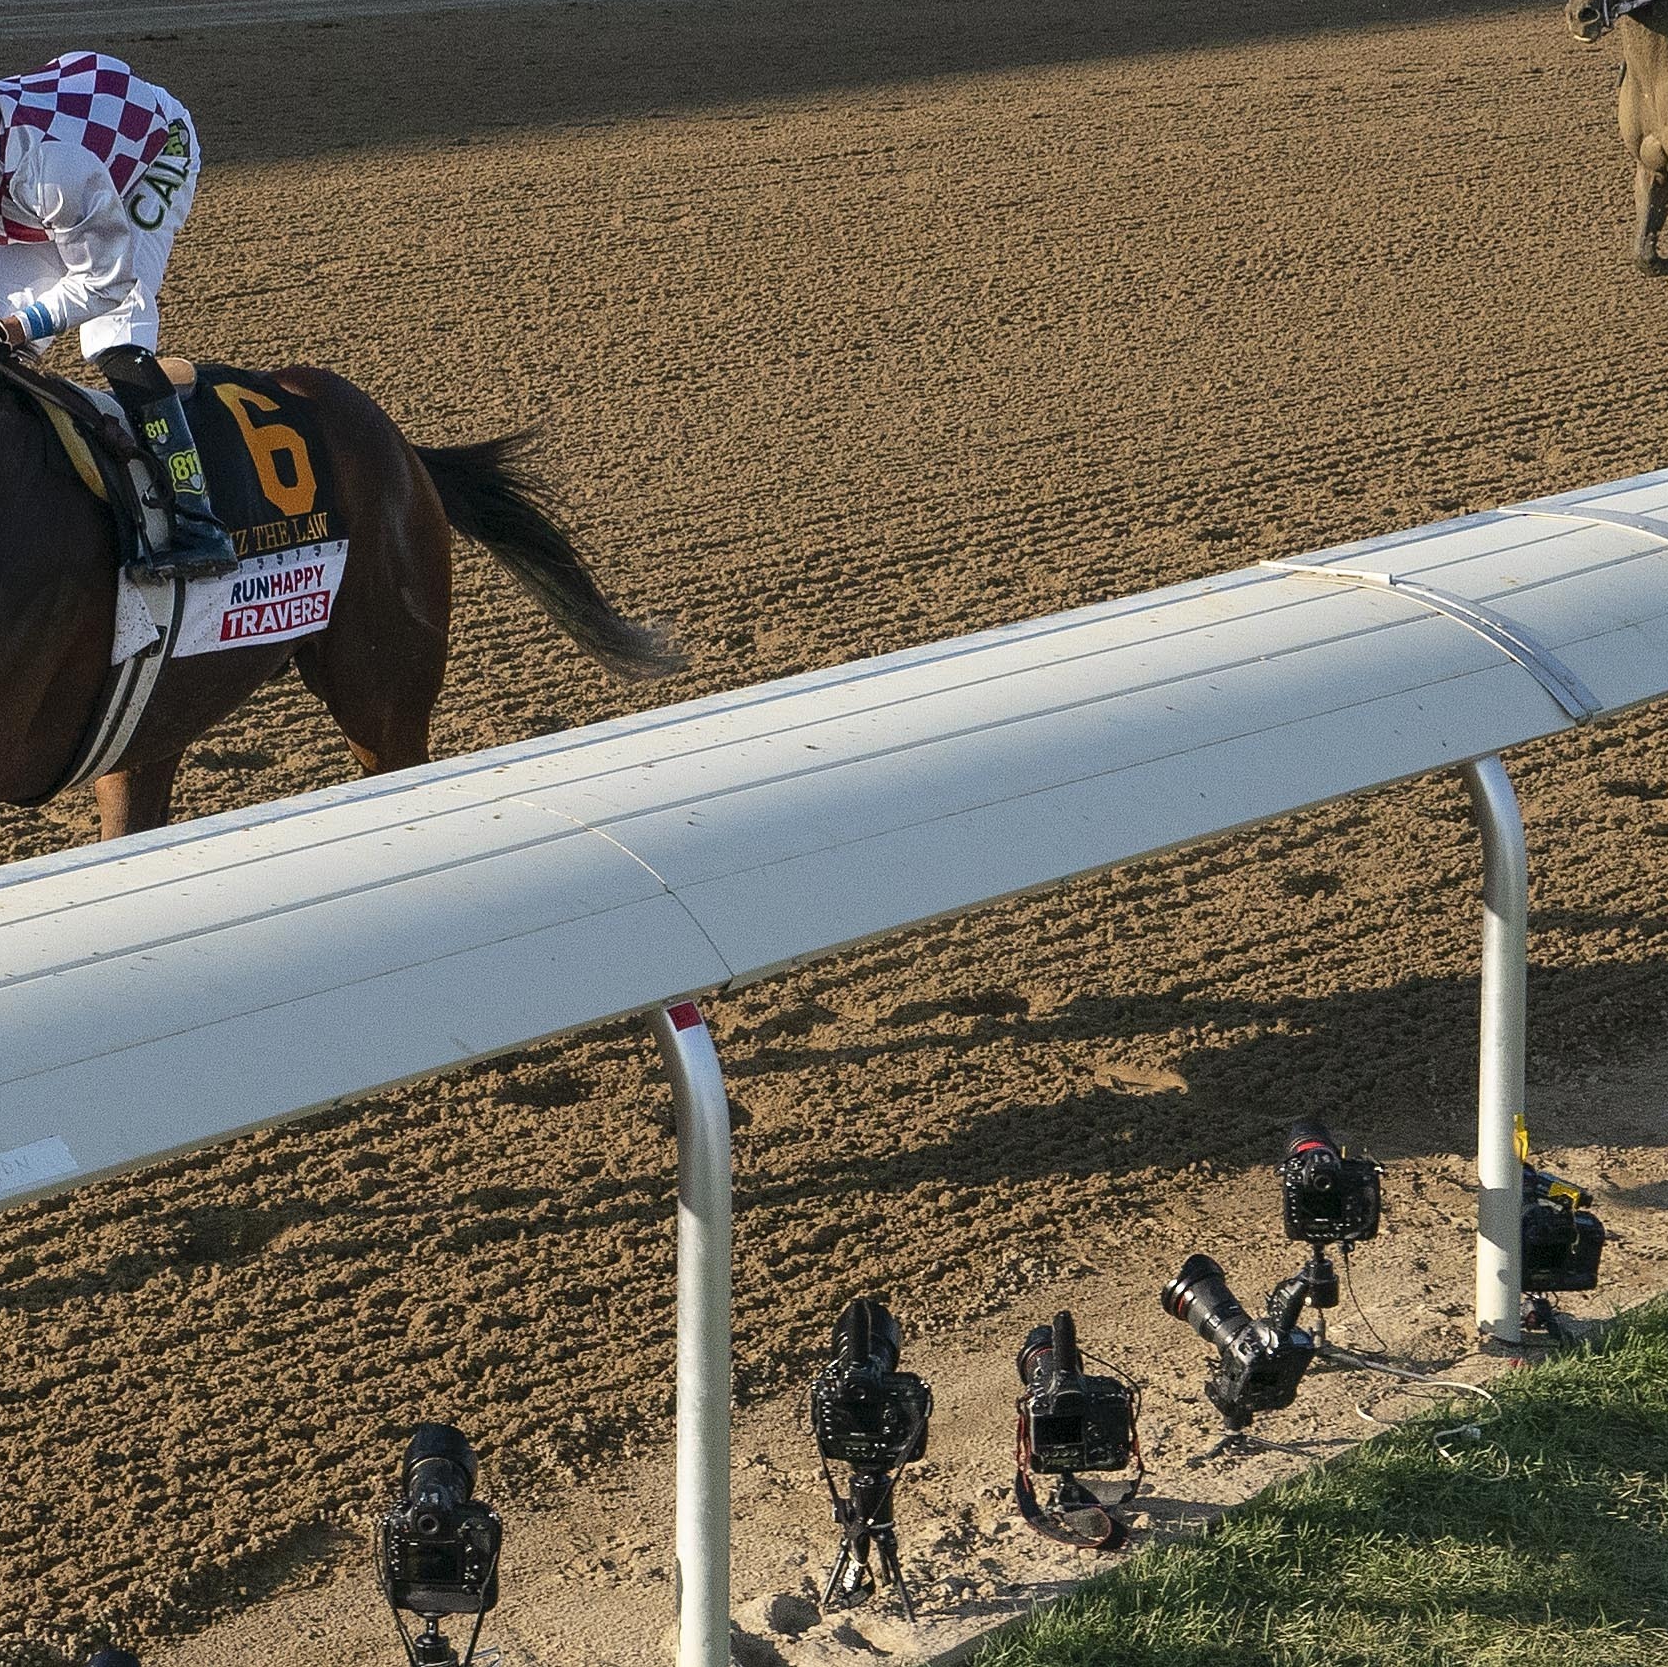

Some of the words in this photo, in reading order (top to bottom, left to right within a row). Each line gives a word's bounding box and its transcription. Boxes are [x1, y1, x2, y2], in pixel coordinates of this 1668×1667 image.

[145, 417, 169, 439] 811
[172, 451, 202, 481] 811
[212, 382, 318, 517] 6
[252, 520, 291, 552] THE
[292, 512, 329, 543] LAW
[230, 564, 326, 605] RUNHAPPY
[226, 594, 326, 638] TRAVERS
